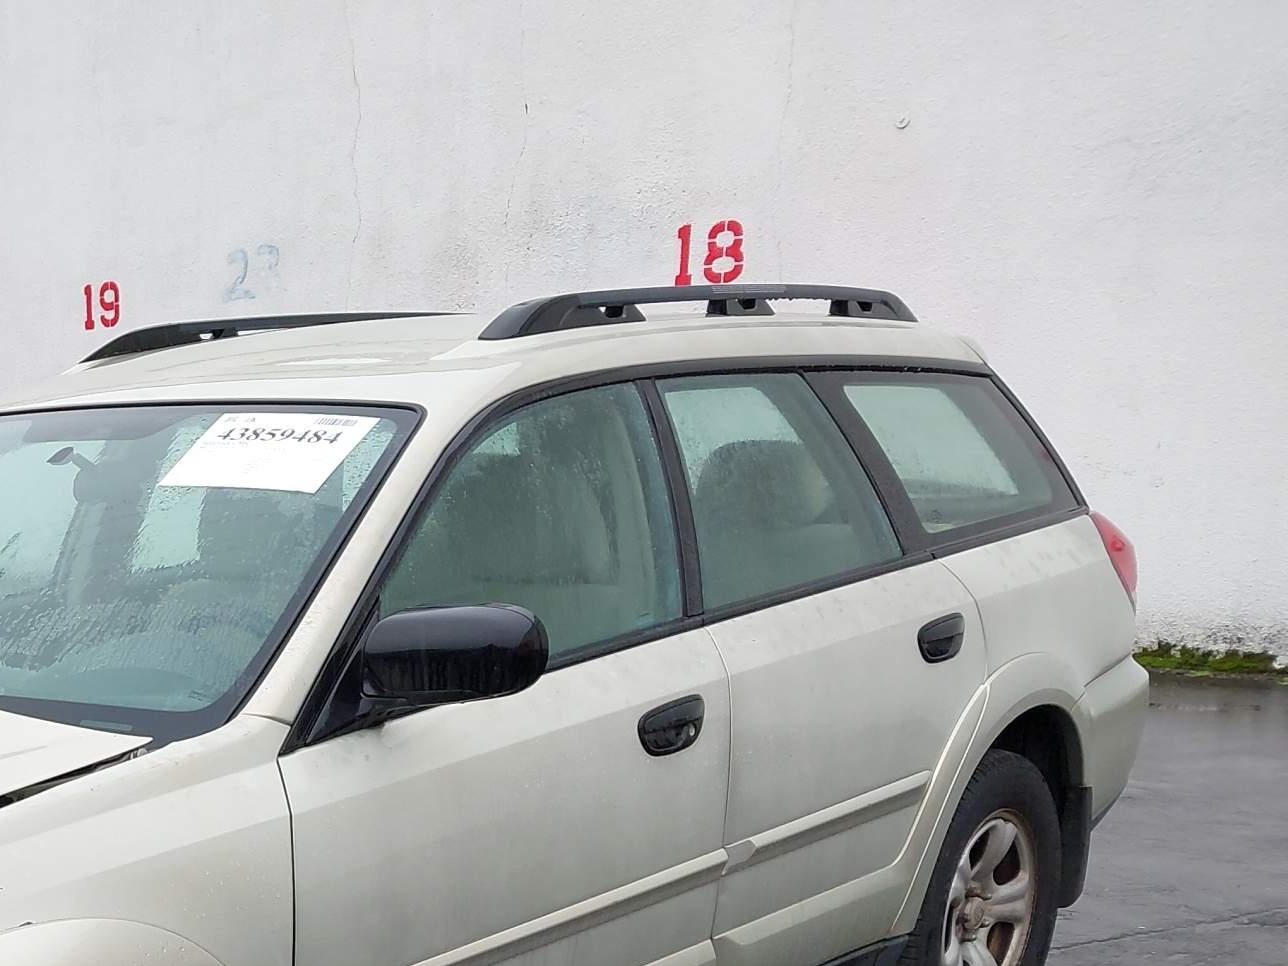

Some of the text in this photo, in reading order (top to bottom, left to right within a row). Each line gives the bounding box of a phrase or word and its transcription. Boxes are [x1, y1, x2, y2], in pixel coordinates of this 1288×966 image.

[674, 219, 744, 287] 18
[83, 281, 121, 331] 19
[217, 427, 343, 444] 43859484
